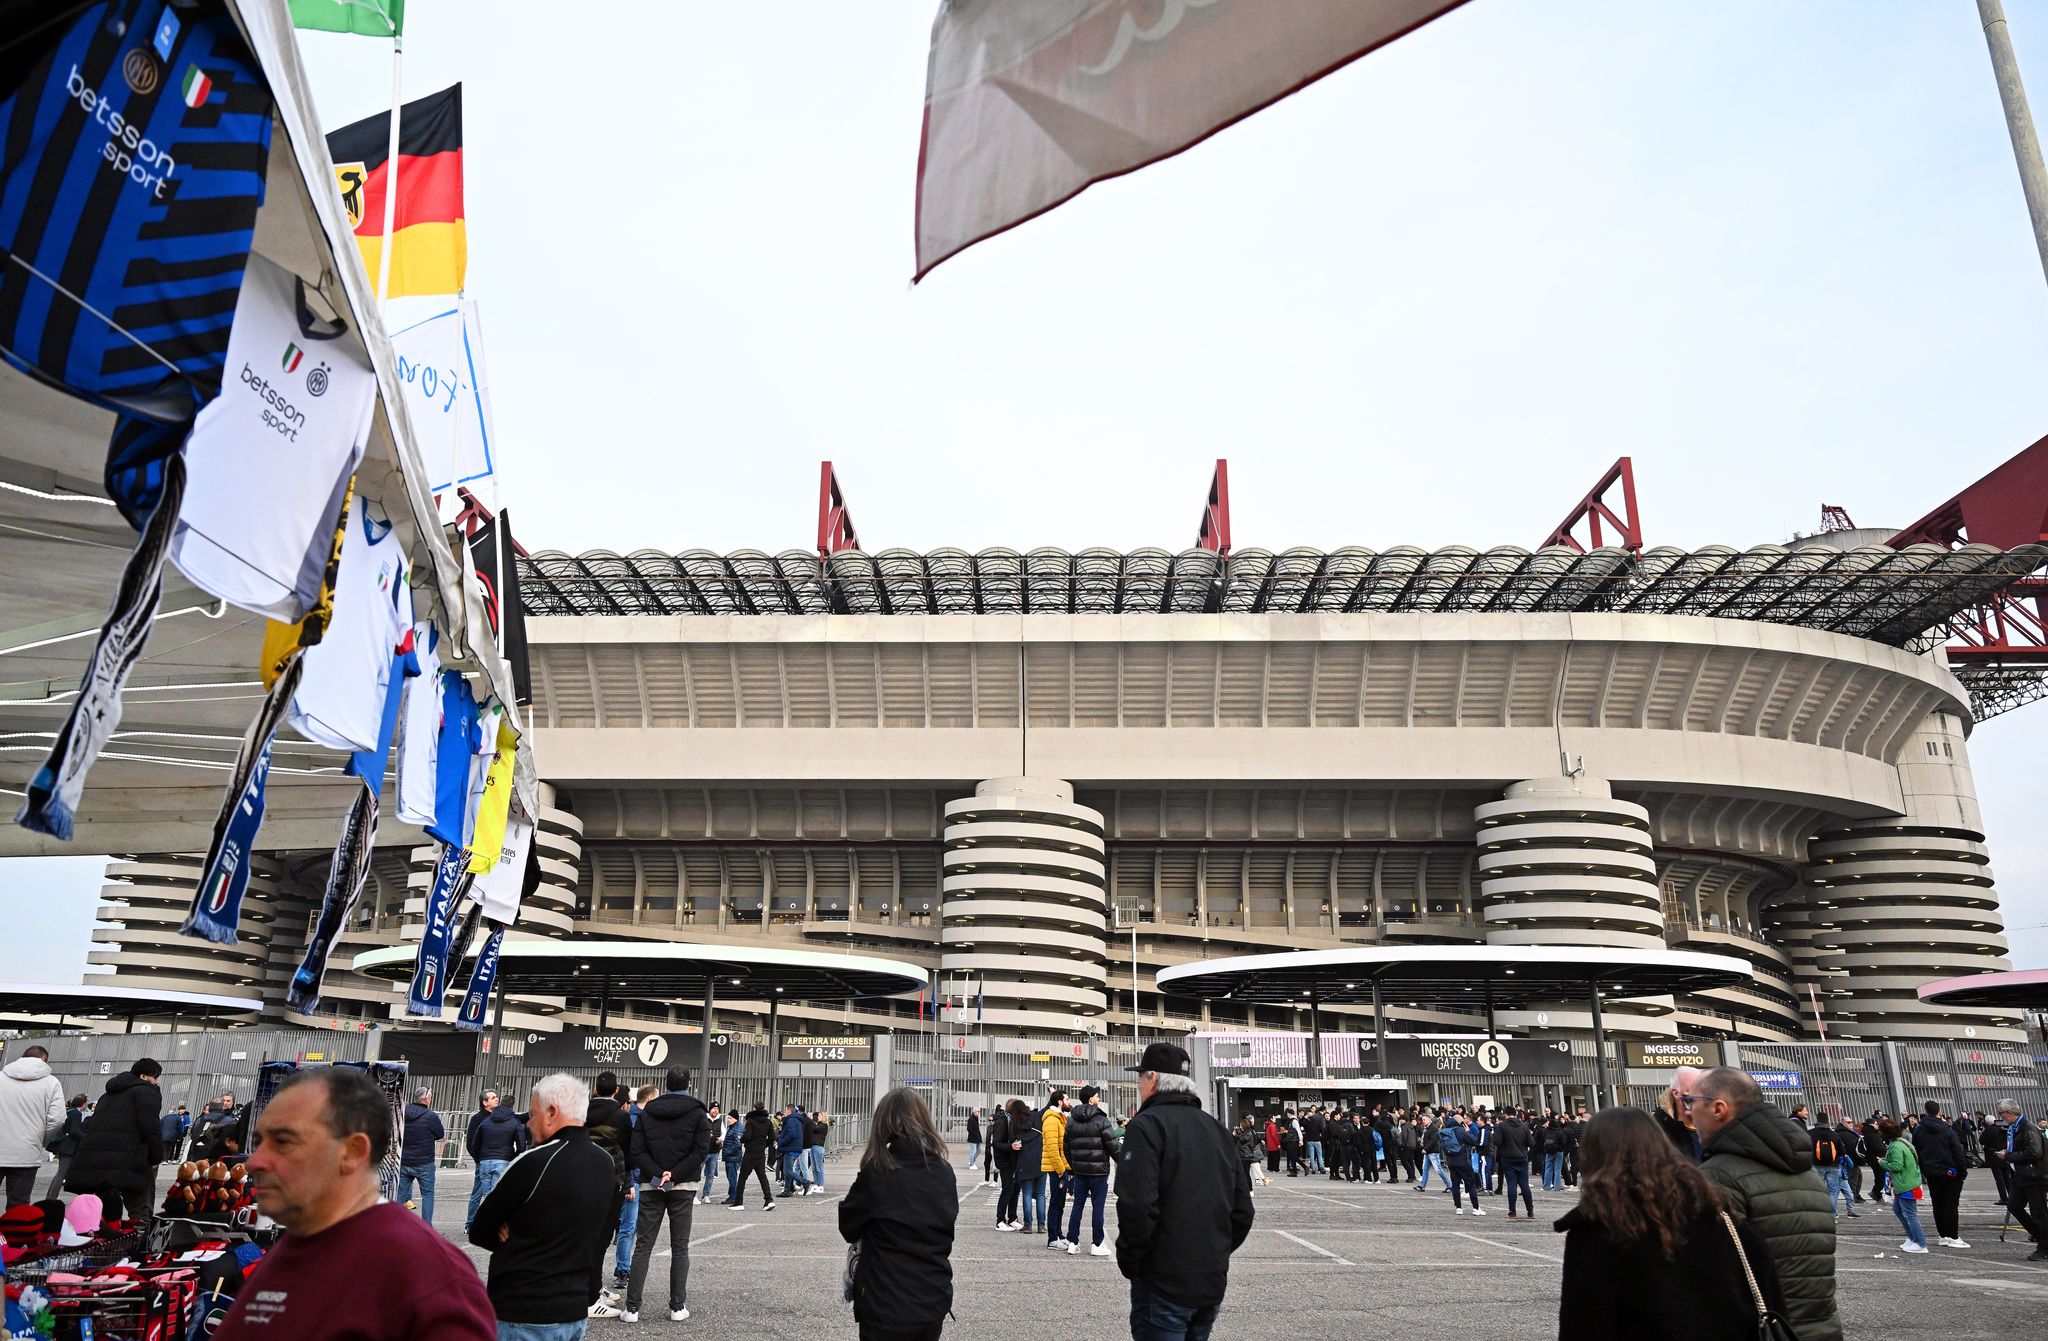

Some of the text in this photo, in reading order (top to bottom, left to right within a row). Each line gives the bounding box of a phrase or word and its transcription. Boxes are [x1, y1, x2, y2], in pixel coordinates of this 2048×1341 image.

[66, 63, 176, 178] betsson
[240, 361, 306, 428] betsson
[432, 861, 455, 939] ITALIA
[478, 932, 504, 982] ITALIA
[584, 1036, 637, 1051] INGRESSO
[787, 1036, 866, 1046] APERTURA INGRESSI
[597, 1050, 621, 1063] GATE
[648, 1038, 660, 1062] 7
[807, 1047, 845, 1060] 18:45
[1421, 1042, 1475, 1058] INGRESSO
[1487, 1045, 1500, 1069] 8
[1644, 1045, 1699, 1055] INGRESSO
[1436, 1057, 1462, 1070] GATE
[1642, 1056, 1704, 1065] DI SERVIZIO
[1300, 1094, 1323, 1103] CASSA
